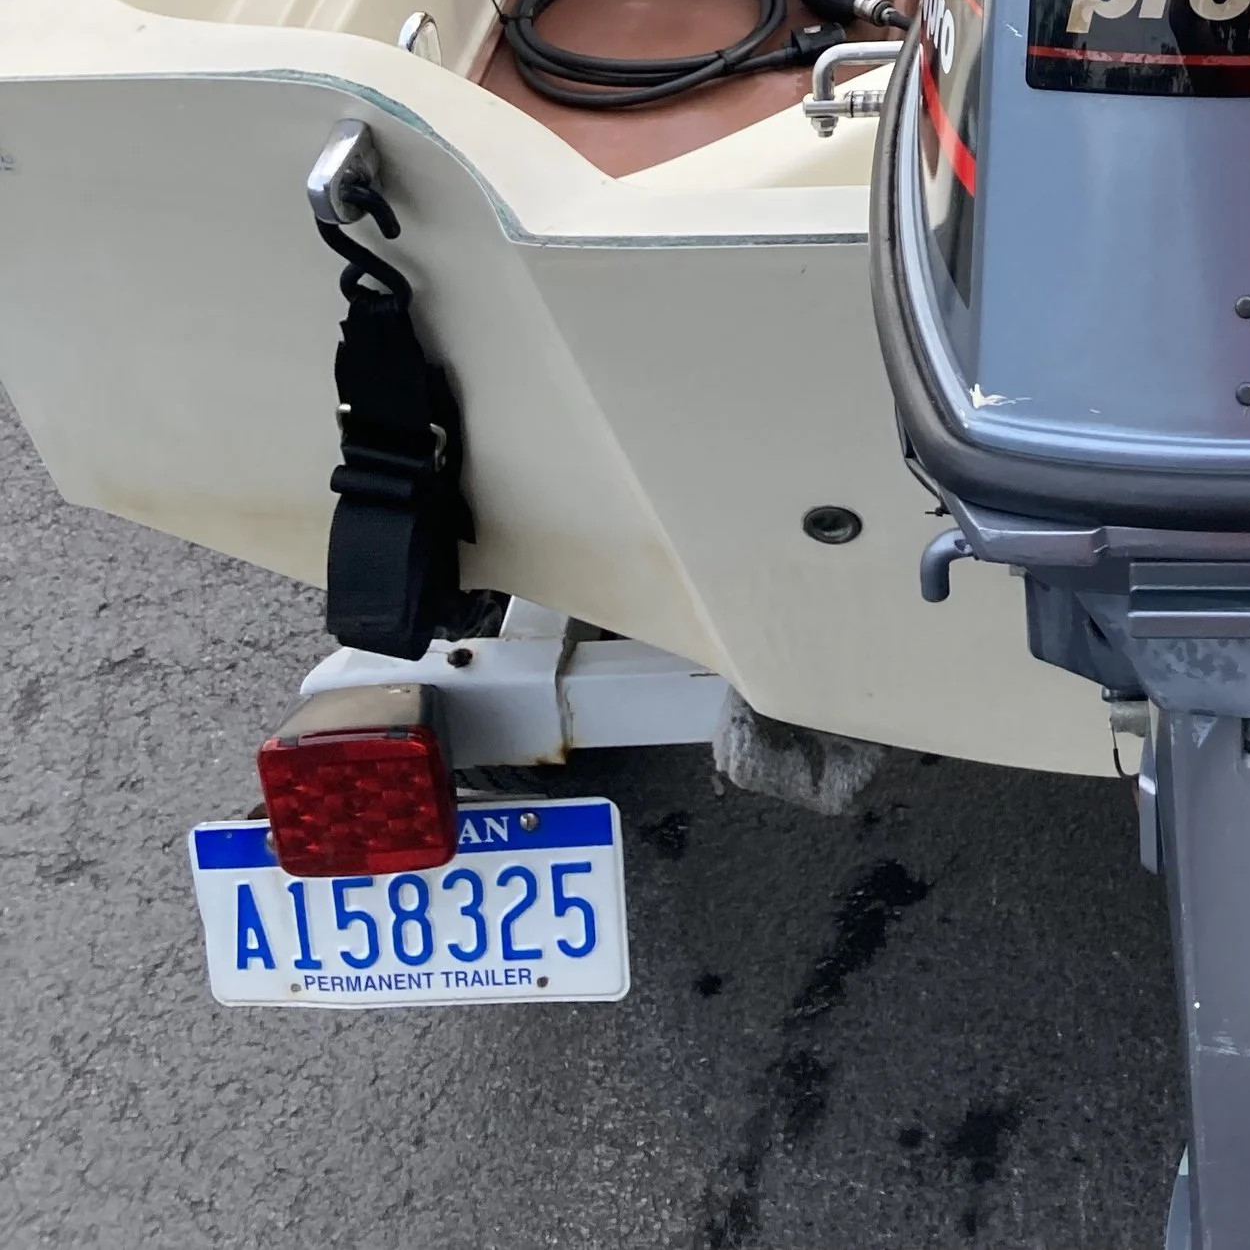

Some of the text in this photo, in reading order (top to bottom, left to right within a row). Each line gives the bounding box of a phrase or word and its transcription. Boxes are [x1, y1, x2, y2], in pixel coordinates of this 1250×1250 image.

[236, 860, 598, 971] A158325
[304, 968, 533, 992] PERMANENT TRAILER
